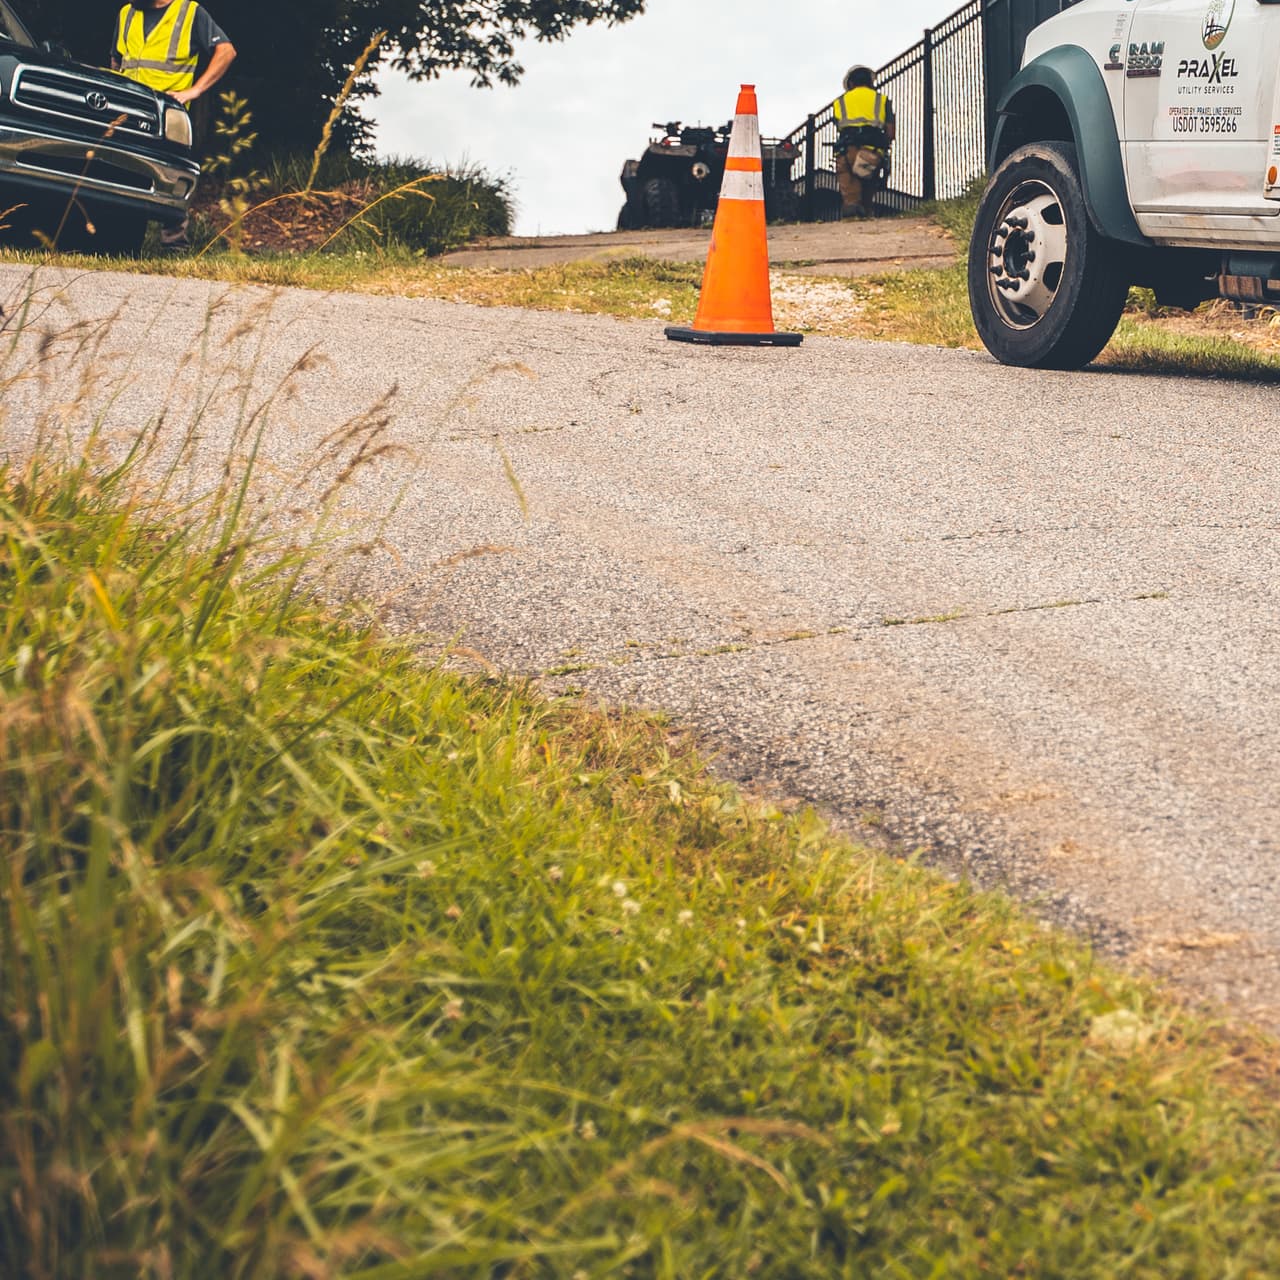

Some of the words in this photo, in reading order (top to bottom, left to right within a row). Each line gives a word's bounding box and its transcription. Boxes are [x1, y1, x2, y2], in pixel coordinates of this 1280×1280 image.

[1129, 41, 1165, 56] RAM
[1127, 55, 1163, 69] 5500
[1177, 51, 1239, 83] PRAXEL
[1178, 86, 1202, 94] UTILITY
[1204, 85, 1234, 94] SERVICES
[1168, 107, 1190, 116] OPERATED
[1212, 107, 1222, 116] LINE
[1222, 107, 1242, 116] SERVICES
[1172, 117, 1198, 132] USDOT
[1200, 117, 1237, 133] 3595266
